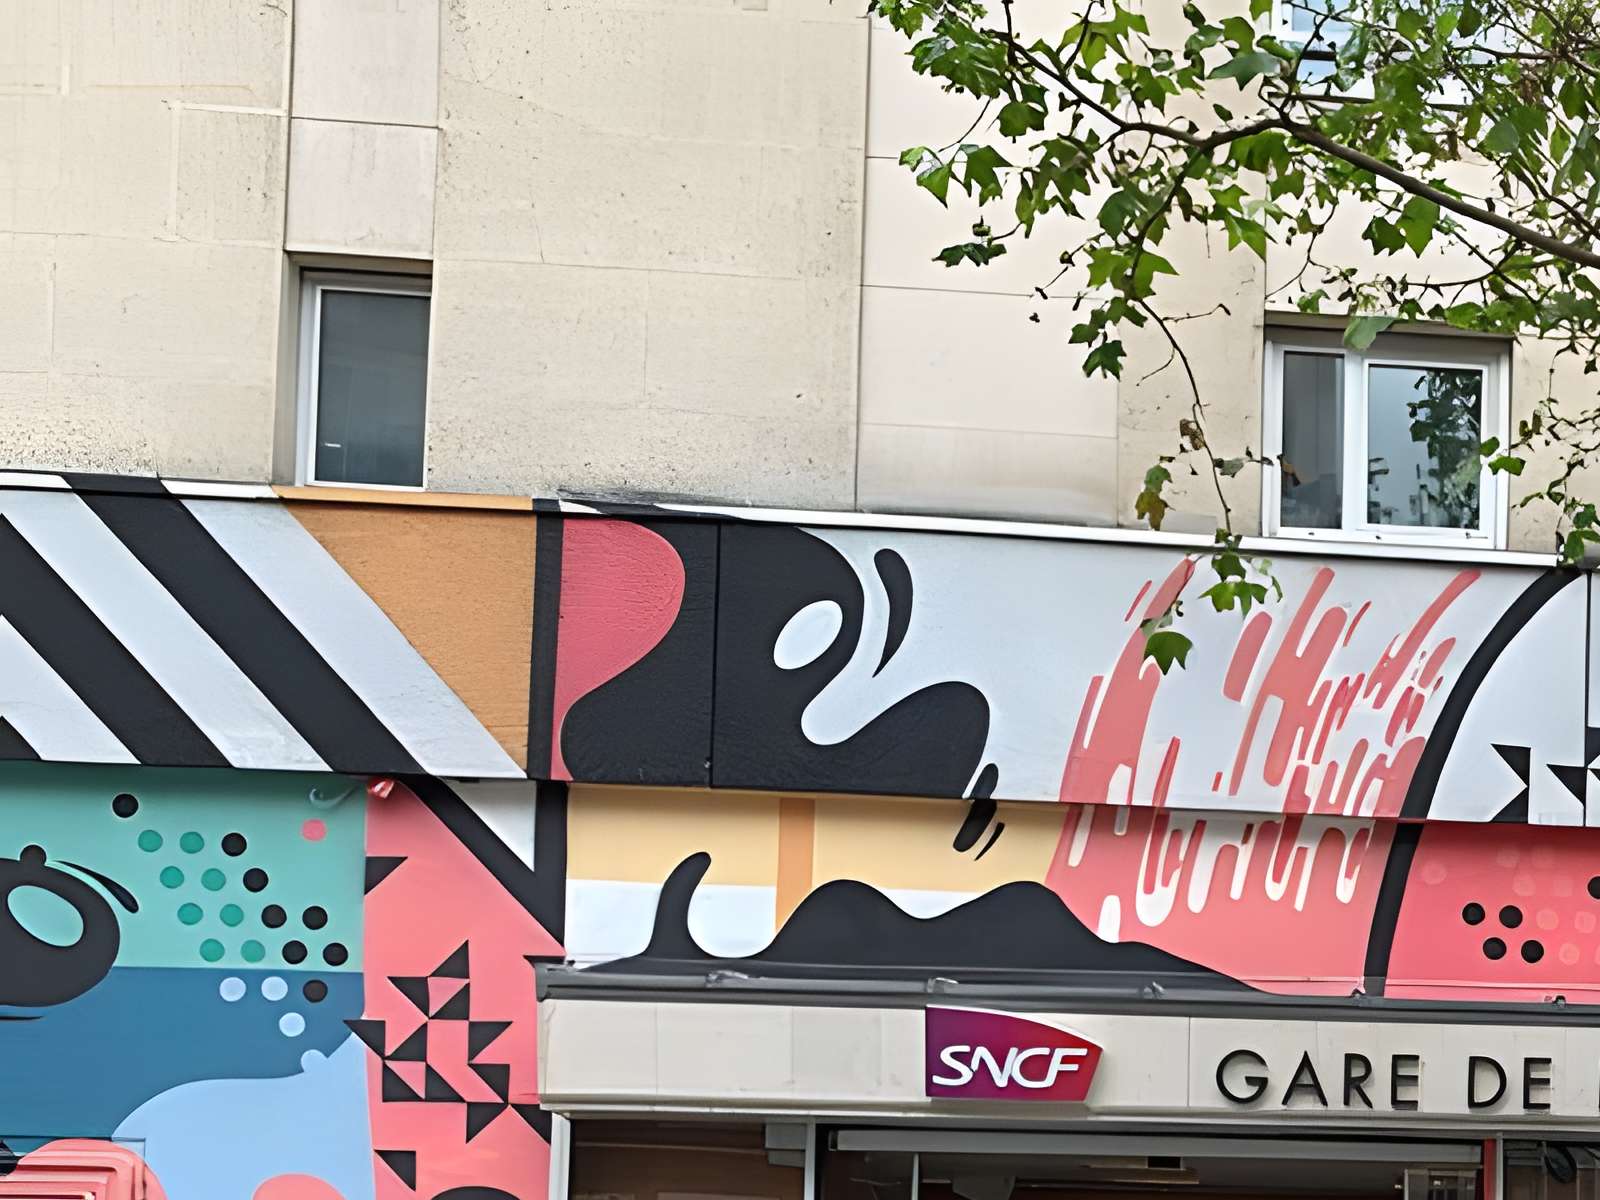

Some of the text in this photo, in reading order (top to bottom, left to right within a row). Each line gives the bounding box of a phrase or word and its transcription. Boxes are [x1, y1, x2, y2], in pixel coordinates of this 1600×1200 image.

[932, 1045, 1087, 1089] SNCF
[1215, 1049, 1420, 1111] GARE
[1467, 1055, 1553, 1111] DE
